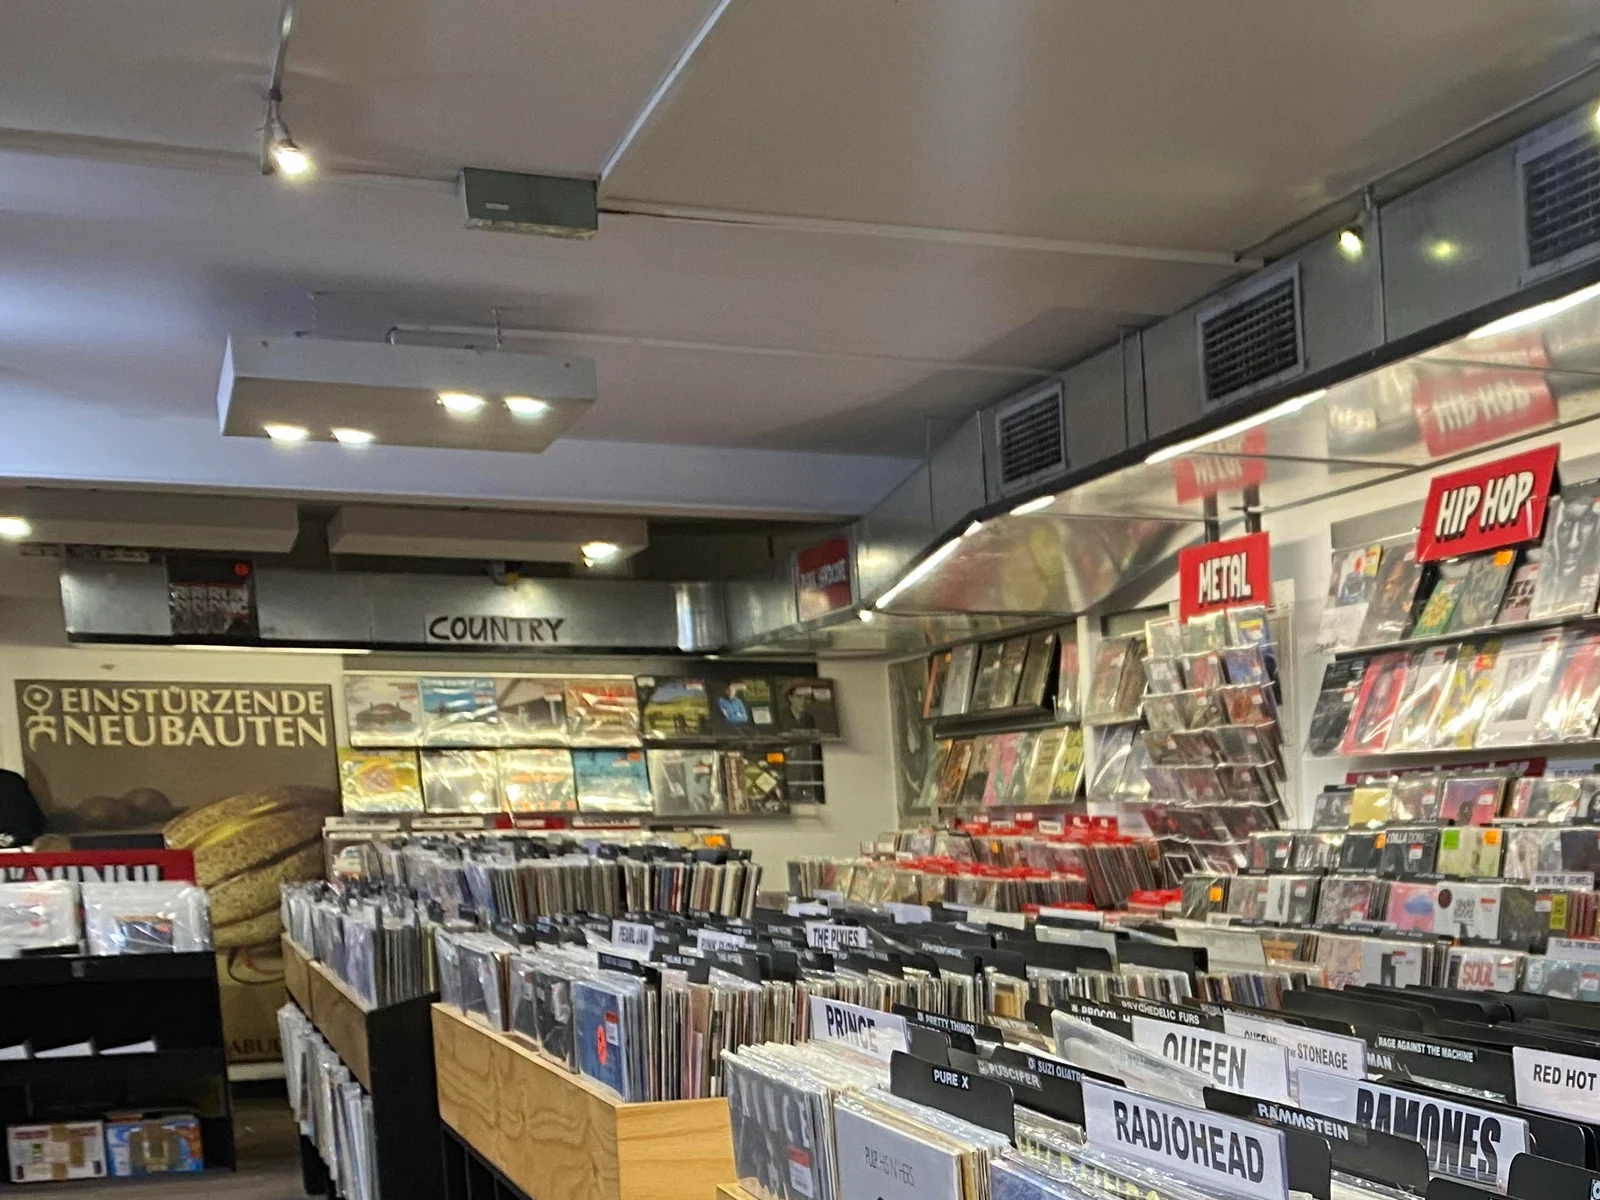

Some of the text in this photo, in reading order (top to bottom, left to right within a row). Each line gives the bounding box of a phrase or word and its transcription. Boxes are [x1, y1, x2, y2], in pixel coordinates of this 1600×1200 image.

[1435, 472, 1534, 538] HIP HOP
[1199, 552, 1251, 604] METAL
[428, 616, 567, 642] COUNTRY
[61, 686, 325, 715] EINSTÜRZENDE
[63, 715, 328, 748] NEUBAUTEN
[813, 928, 859, 947] THE PIXIES
[1462, 962, 1495, 987] SOUL
[826, 1004, 878, 1053] PRINCE
[925, 1013, 975, 1036] PRETTY THINGS
[1178, 1011, 1200, 1025] FURS
[1297, 1043, 1348, 1070] STONEAGE
[1378, 1034, 1474, 1063] RAGE AGAINST THE MACHINE
[934, 1068, 970, 1089] PURE X
[987, 1061, 1041, 1089] PUSCIFER
[1037, 1061, 1054, 1076] SUZI
[1533, 1064, 1561, 1086] RED
[1566, 1069, 1597, 1091] HOT
[1257, 1102, 1350, 1141] RAMMSTEIN
[1356, 1088, 1502, 1182] RAMONES
[1113, 1099, 1265, 1184] RADIOHEAD
